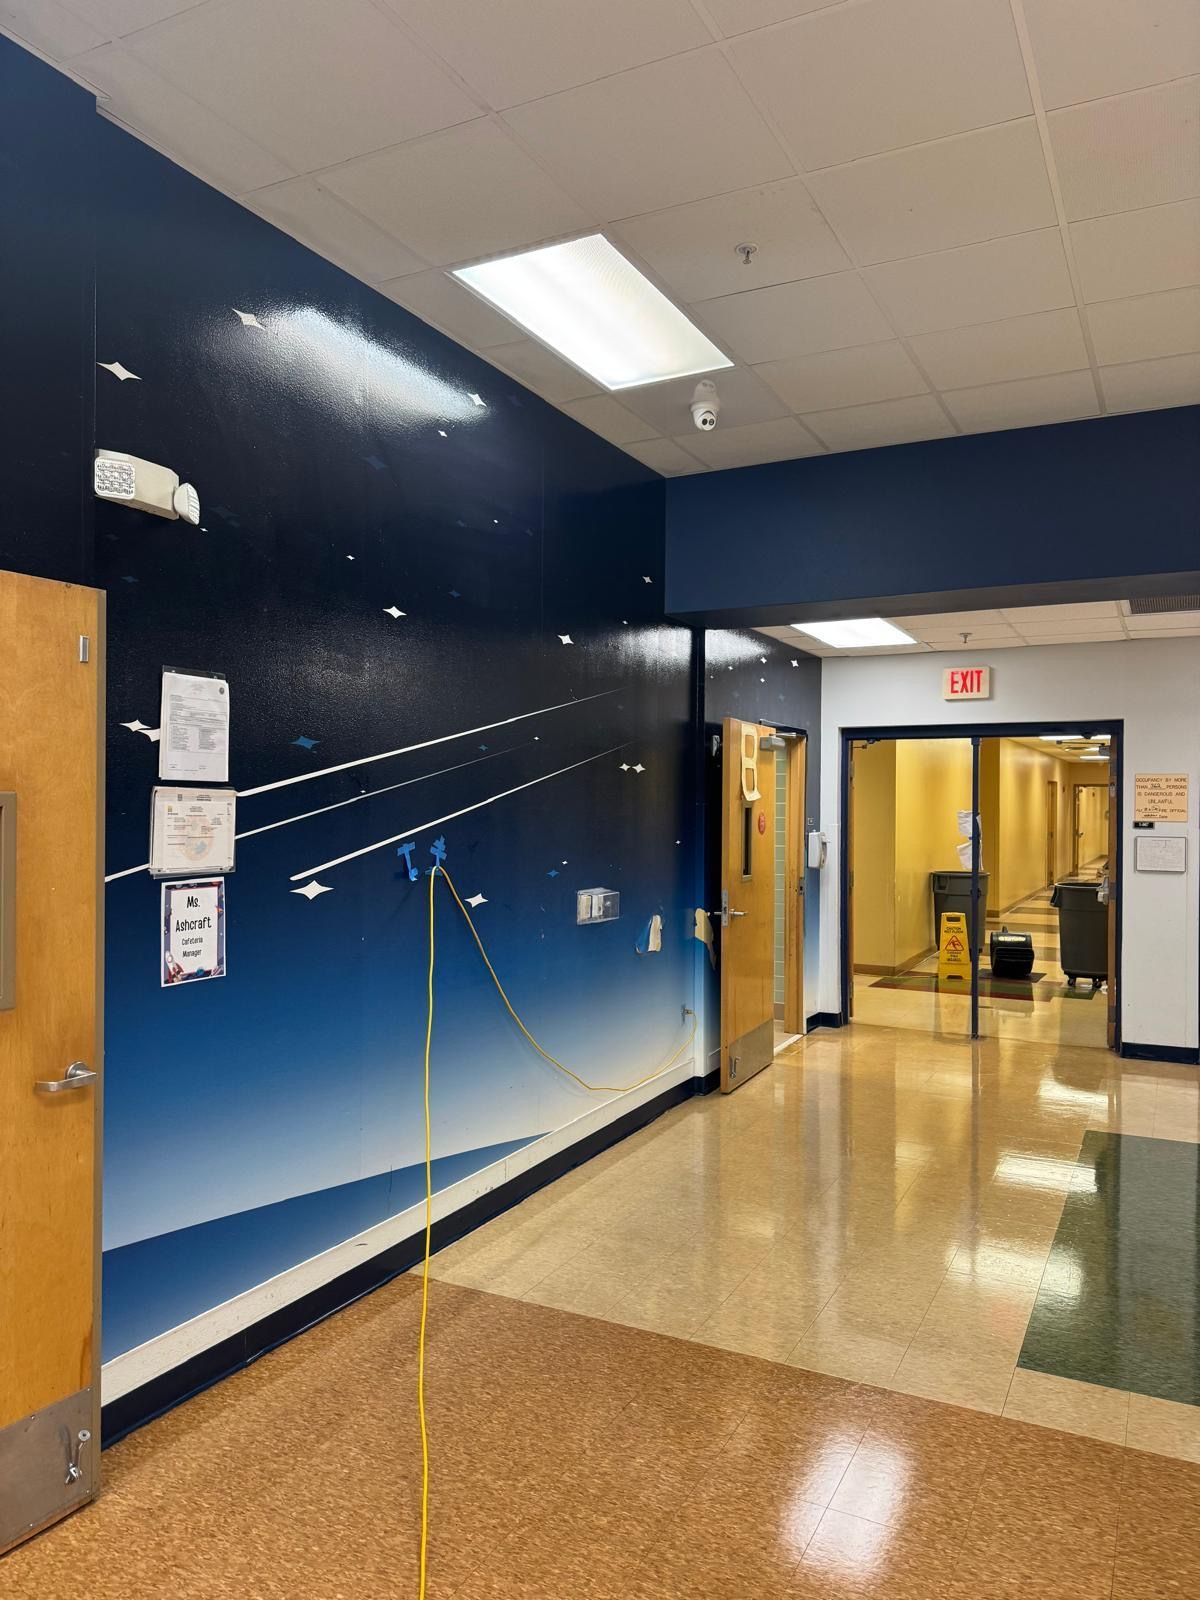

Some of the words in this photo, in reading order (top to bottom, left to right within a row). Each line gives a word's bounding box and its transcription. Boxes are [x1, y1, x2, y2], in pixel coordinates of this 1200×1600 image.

[950, 669, 983, 694] EXIT
[187, 896, 200, 908] Ms.
[175, 916, 212, 932] Ashcraft
[181, 937, 203, 945] Cafeteria
[182, 949, 202, 958] Manager
